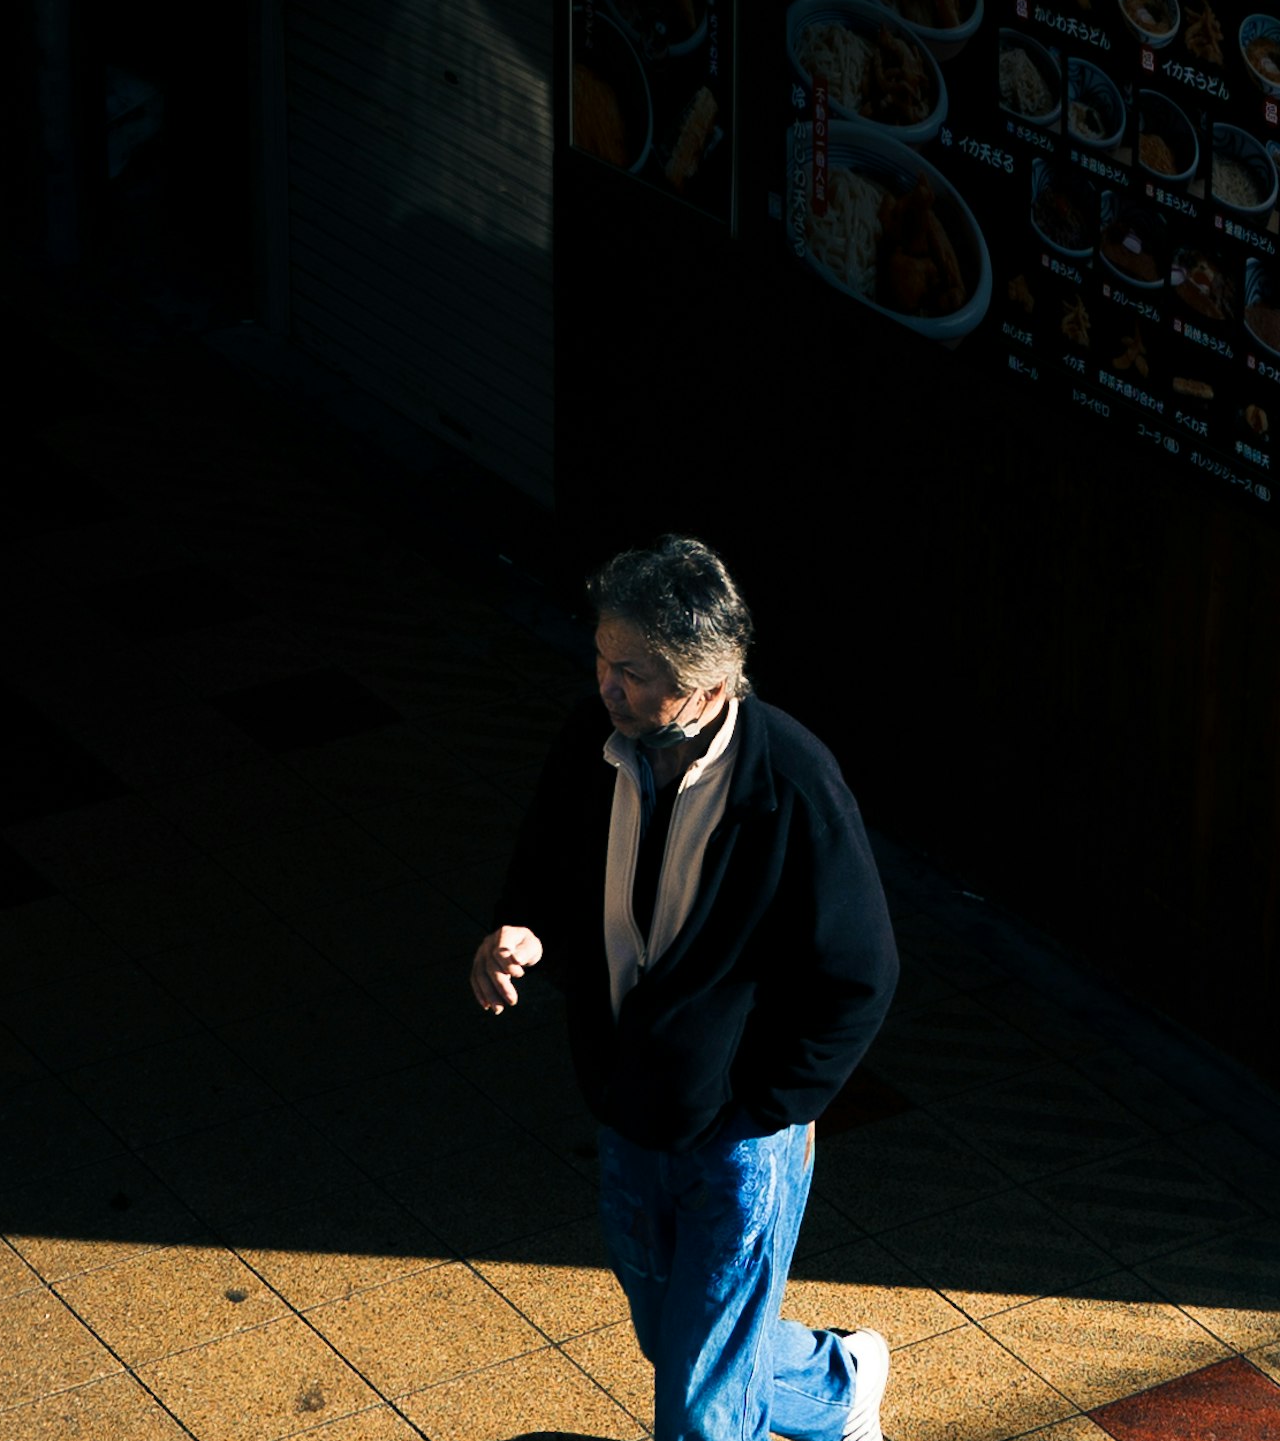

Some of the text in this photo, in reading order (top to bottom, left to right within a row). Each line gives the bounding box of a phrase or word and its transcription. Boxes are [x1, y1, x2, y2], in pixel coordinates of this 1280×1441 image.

[1161, 58, 1231, 102] イカ天うどん
